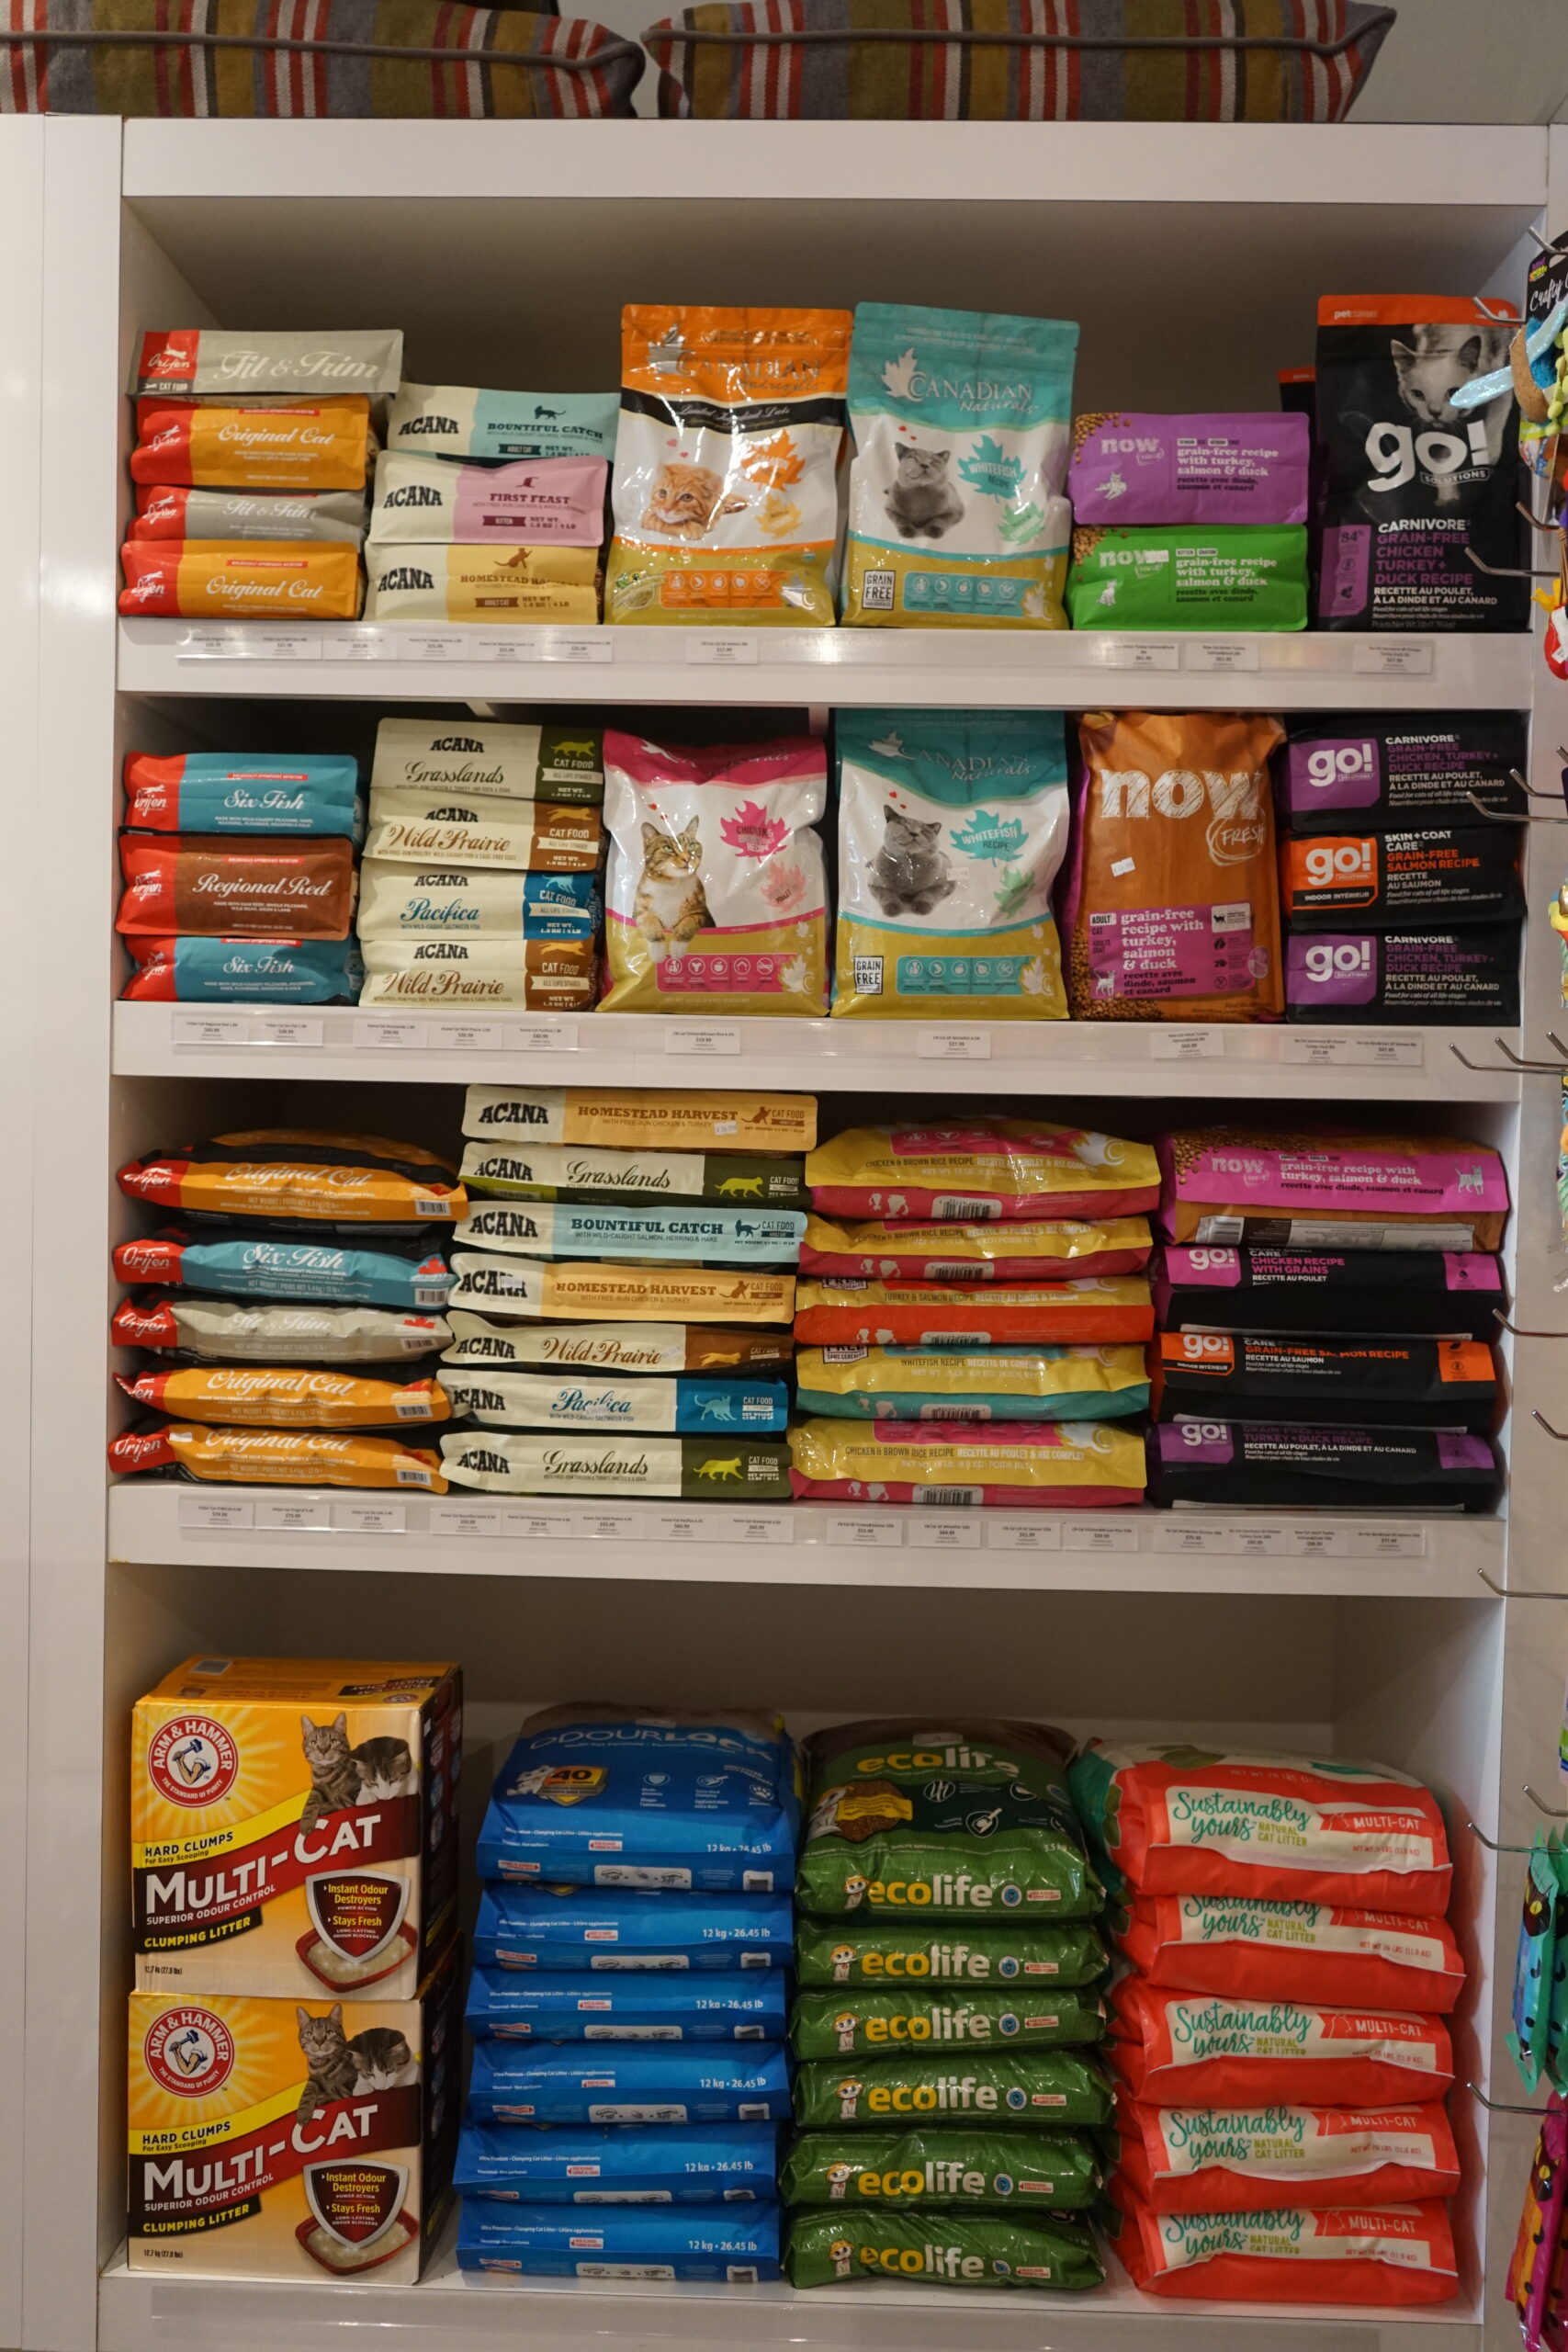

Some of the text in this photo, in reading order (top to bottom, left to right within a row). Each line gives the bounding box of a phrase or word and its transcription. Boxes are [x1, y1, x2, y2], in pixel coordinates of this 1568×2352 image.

[213, 351, 378, 379] Fit & Trim
[908, 371, 1032, 401] CANADIAN
[960, 401, 1034, 413] Naturals
[399, 416, 458, 435] ACANA
[219, 424, 335, 447] Original Cat
[1101, 438, 1159, 455] now
[1178, 447, 1279, 458] grain-free recipe
[1366, 420, 1488, 492] go!
[969, 463, 1017, 478] WHITEFISH
[1425, 469, 1486, 484] SOLUTIONS
[384, 486, 442, 508] ACANA
[490, 493, 570, 503] FIRST FEAST
[1379, 519, 1466, 533] CARNIVORE
[1378, 533, 1470, 544] GRAIN-FREE
[1377, 546, 1444, 558] CHICKEN
[378, 568, 434, 592] ACANA
[867, 575, 892, 585] GRAIN
[1375, 573, 1473, 584] DUCK RECIPE
[866, 587, 892, 599] FREE
[1374, 586, 1473, 596] RECETTE AU POULET,
[430, 738, 484, 752] ACANA
[1385, 735, 1455, 744] CARNIVORE
[554, 759, 593, 768] CAT FOOD
[1308, 743, 1372, 786] go!
[405, 761, 504, 783] Grasslands
[224, 789, 304, 808] Six Fish
[1100, 770, 1260, 820] now
[424, 808, 479, 822] ACANA
[388, 825, 510, 852] Wild Prairie
[961, 827, 1016, 844] WHITEFISH
[1386, 842, 1418, 851] CARE
[1387, 850, 1458, 861] GRAIN-FREE
[1306, 843, 1370, 886] go!
[1387, 858, 1480, 871] SALMON RECIPE
[414, 875, 468, 887] ACANA
[1387, 872, 1428, 881] RECETTE
[193, 874, 329, 898] Regional Red
[400, 898, 479, 922] Pacifica
[1121, 909, 1194, 923] grain-free
[1122, 921, 1203, 935] recipe with
[1122, 935, 1177, 947] turkey,
[413, 944, 468, 959] ACANA
[1122, 947, 1175, 958] salmon
[857, 961, 880, 971] GRAIN
[1122, 958, 1177, 970] & duck
[1305, 941, 1370, 982] go!
[857, 973, 879, 984] FREE
[479, 1102, 548, 1125] ACANA
[578, 1106, 738, 1121] HOMESTEAD HARVEST
[474, 1158, 533, 1182] ACANA
[865, 1157, 974, 1168] CHICKEN & BROWN RICE RECIPE
[1213, 1156, 1265, 1174] now
[567, 1160, 671, 1189] Grasslands
[469, 1213, 537, 1237] ACANA
[571, 1218, 723, 1234] BOUNTIFUL CATCH
[592, 1232, 636, 1240] WILD-CAUGHT
[666, 1234, 692, 1242] HERRING
[122, 1246, 171, 1275] Orijen
[1251, 1257, 1302, 1265] CHICKEN
[1252, 1265, 1328, 1274] WITH GRAINS
[556, 1283, 716, 1295] HOMESTEAD HARVEST
[456, 1337, 515, 1360] ACANA
[114, 1437, 163, 1463] Orijen
[845, 1446, 874, 1455] CHICKEN
[884, 1446, 908, 1456] BROWN
[911, 1448, 927, 1458] RICE
[930, 1448, 954, 1457] RECIPE
[957, 1448, 987, 1458] RECETTE
[989, 1449, 998, 1458] AU
[1001, 1449, 1028, 1459] POULET
[1030, 1450, 1036, 1459] &
[1038, 1450, 1050, 1459] RIZ
[1052, 1450, 1085, 1461] COMPLET
[458, 1450, 509, 1474] ACANA
[152, 1720, 231, 1770] ARM & HAMMER
[1174, 1792, 1311, 1831] Sustainably
[1190, 1818, 1254, 1843] yours
[1258, 1822, 1298, 1836] NATURAL
[1354, 1816, 1420, 1831] MULTI-CAT
[145, 1832, 233, 1857] HARD CLUMPS
[147, 1815, 380, 1914] MULTI-CAT
[158, 1854, 174, 1865] Easy
[176, 1849, 209, 1862] Scooping
[328, 1884, 388, 1894] Instant Odour
[867, 1874, 993, 1907] ecolife
[147, 1884, 276, 1925] SUPERIOR ODOUR CONTROL
[334, 1894, 381, 1905] Destroyers
[333, 1916, 382, 1928] Stays Fresh
[144, 1917, 251, 1948] CLUMPING LITTER
[862, 1945, 990, 1977] ecolife
[865, 2007, 990, 2041] ecolife
[1174, 2003, 1312, 2043] Sustainably
[1356, 2022, 1423, 2037] MULTI-CAT
[869, 2076, 998, 2111] ecolife
[142, 2121, 231, 2144] HARD CLUMPS
[144, 2105, 378, 2200] MULTI-CAT
[859, 2162, 985, 2196] ecolife
[143, 2204, 249, 2233] CLUMPING LITTER
[689, 2240, 757, 2251] 12 kg 26.45 lb
